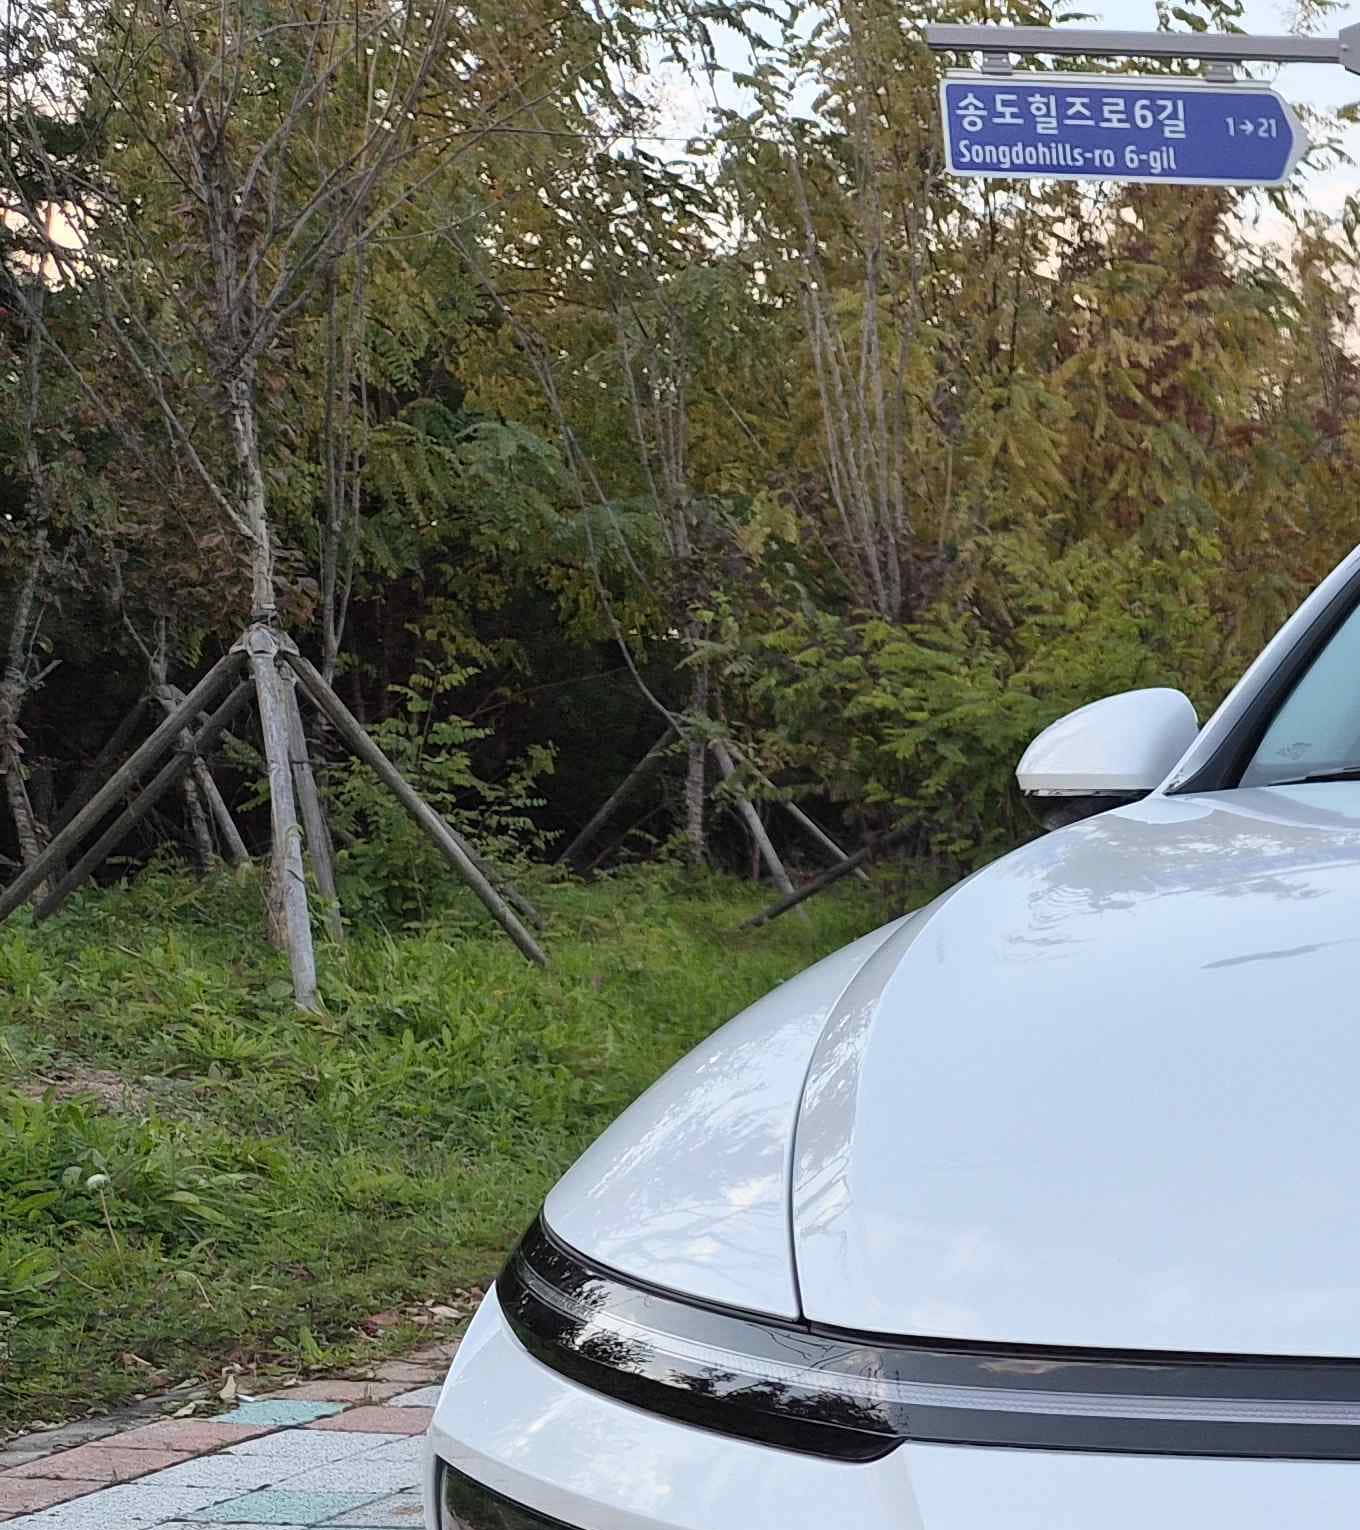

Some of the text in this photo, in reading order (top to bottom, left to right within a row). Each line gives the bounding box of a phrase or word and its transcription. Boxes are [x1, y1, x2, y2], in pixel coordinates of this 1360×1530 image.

[955, 92, 1186, 139] 송도힐즈로6길
[959, 139, 1176, 174] Songdohills-ro 6-gil
